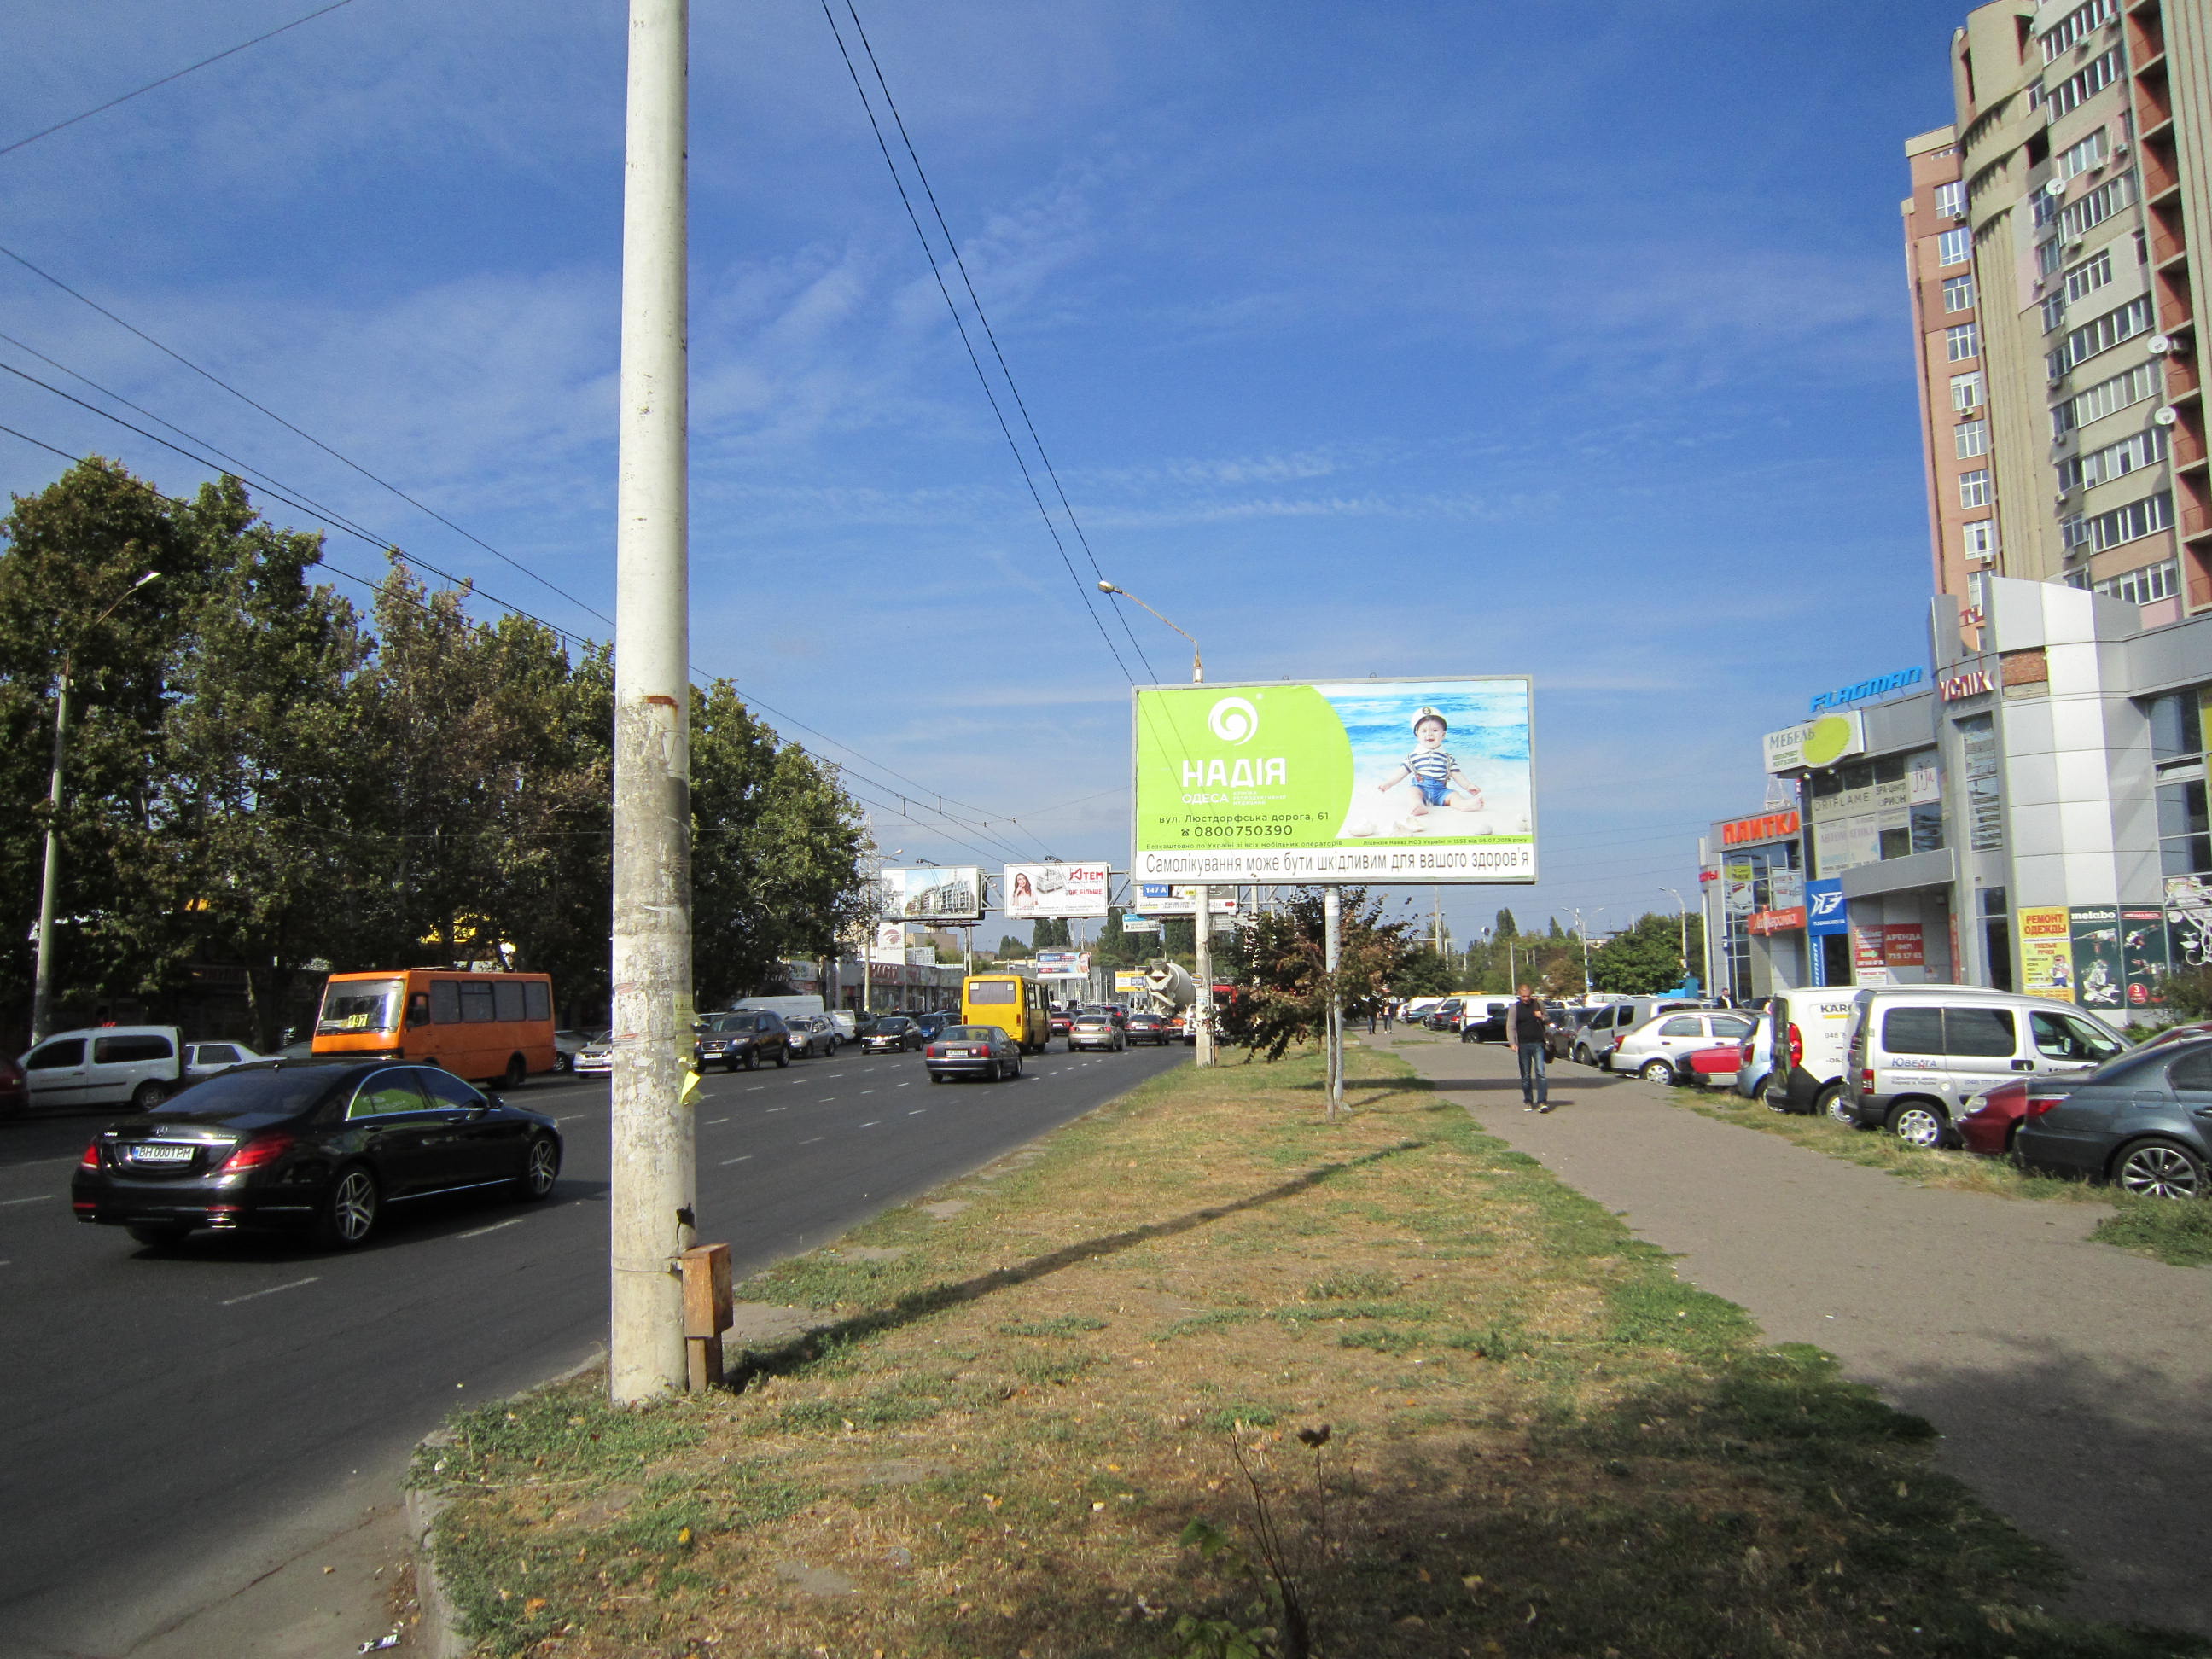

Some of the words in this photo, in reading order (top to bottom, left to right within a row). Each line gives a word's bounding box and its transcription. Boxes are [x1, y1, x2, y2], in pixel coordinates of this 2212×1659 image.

[1809, 666, 1922, 713] FLAGMAN
[1770, 728, 1815, 749] МЕБЕЛЬ
[1182, 757, 1286, 788] НАДІЯ
[1181, 793, 1229, 805] ОДЕСА
[1185, 814, 1268, 824] Люстдорфська
[1272, 813, 1314, 823] дорога,
[1194, 825, 1293, 837] 0800750390
[1722, 812, 1800, 845] ПЛИТКА
[1147, 853, 1242, 876] Самолікування
[1246, 855, 1279, 871] може
[1284, 851, 1313, 876] бути
[1317, 850, 1387, 872] шкідливим
[1391, 854, 1415, 872] для
[1420, 852, 1467, 869] вашого
[1471, 847, 1528, 872] здоров'я
[2026, 914, 2064, 924] РЕМОНТ
[2071, 911, 2116, 920] metabo
[2024, 924, 2067, 935] ОДЕЖДЫ
[350, 1015, 366, 1027] 197
[154, 1147, 176, 1158] 0001
